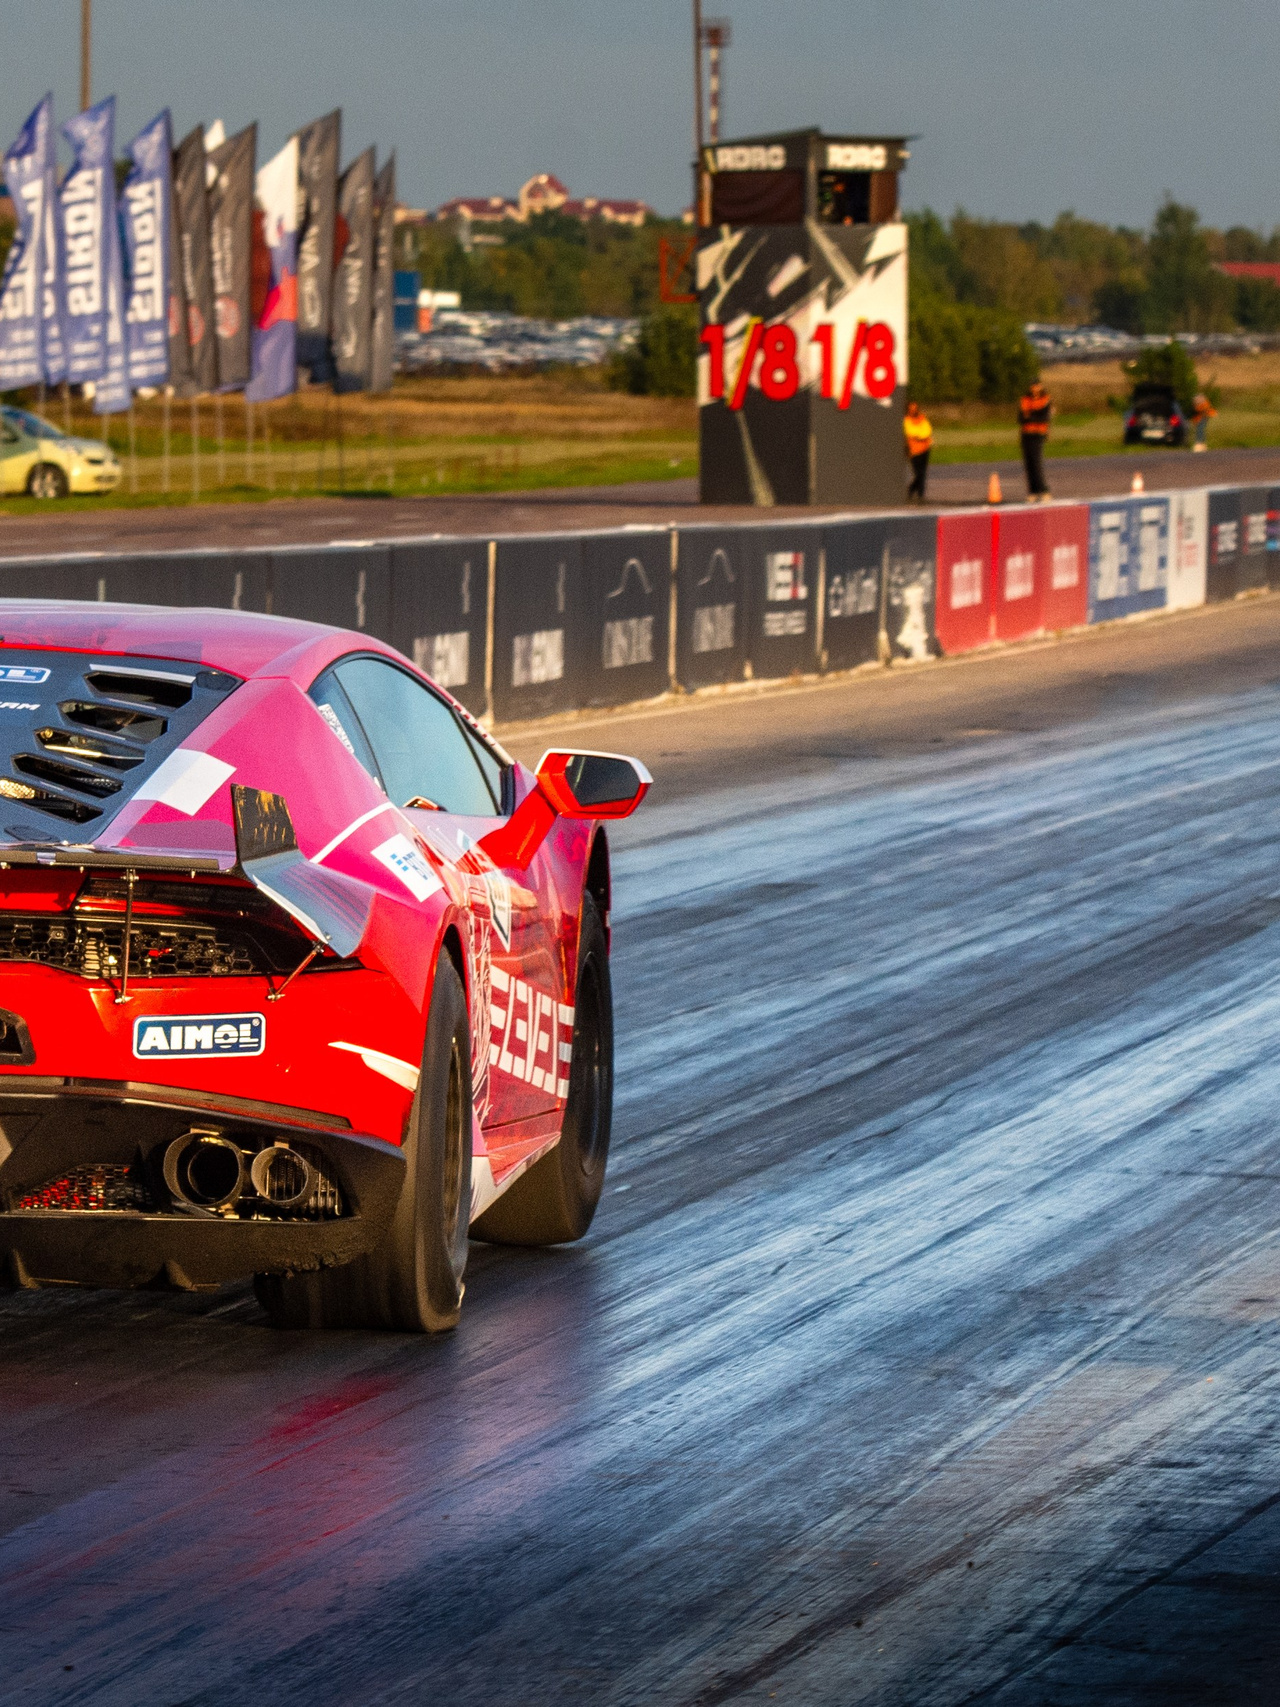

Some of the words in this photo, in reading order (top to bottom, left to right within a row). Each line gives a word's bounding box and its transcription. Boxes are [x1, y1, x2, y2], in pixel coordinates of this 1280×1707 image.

[699, 321, 799, 411] 1/8
[812, 321, 896, 411] 1/8
[138, 1023, 260, 1051] AIMOL
